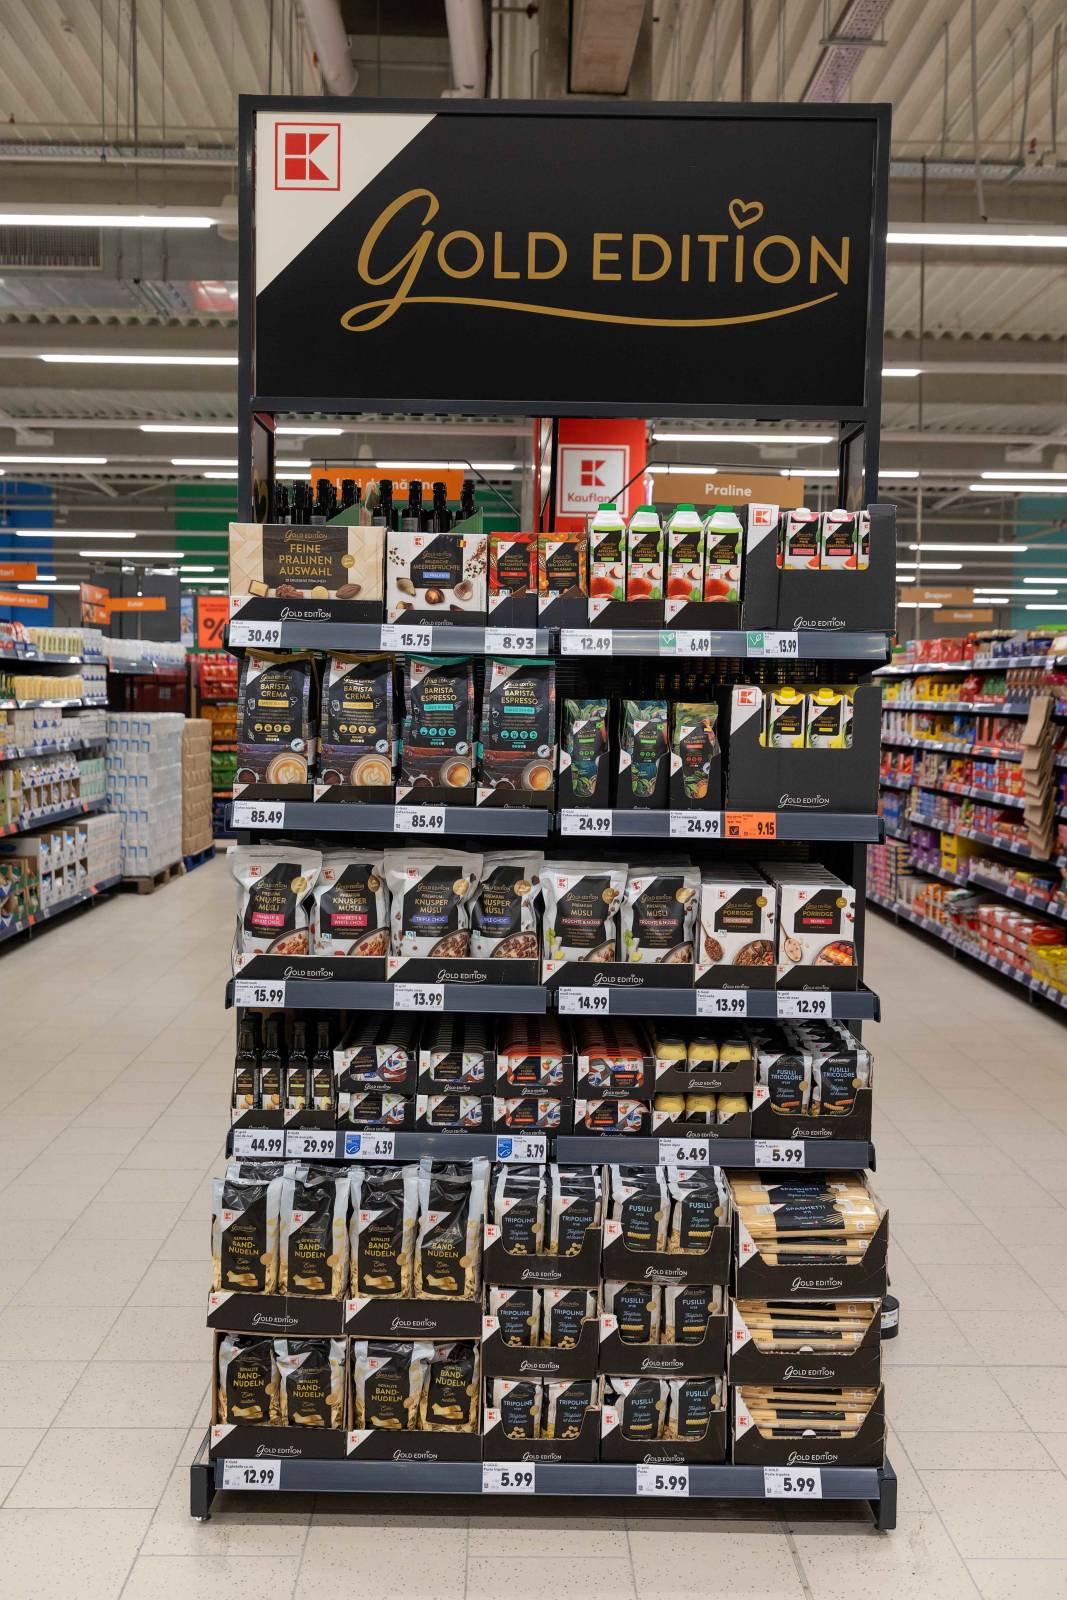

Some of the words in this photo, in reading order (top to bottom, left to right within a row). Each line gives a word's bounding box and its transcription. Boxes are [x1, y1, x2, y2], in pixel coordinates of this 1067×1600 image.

[340, 188, 567, 332] GOLD
[592, 198, 850, 284] EDITION
[705, 483, 752, 497] Praline
[290, 544, 321, 554] FEINE
[279, 554, 332, 565] PRALINEN
[279, 567, 333, 577] AUSWAHL
[279, 606, 303, 622] GOLD
[304, 608, 331, 618] EDITION
[792, 617, 817, 631] GOLD
[818, 617, 846, 627] EDITION
[248, 630, 279, 642] 30.49
[401, 633, 430, 646] 15.75
[503, 636, 534, 650] 8.93
[581, 638, 610, 651] 12.49
[690, 638, 709, 651] 6.49
[778, 640, 797, 653] 13.99
[260, 682, 290, 691] BARISTA
[343, 685, 373, 693] BARISTA
[260, 690, 288, 698] CREMA
[345, 692, 371, 700] CREMA
[420, 694, 458, 702] ESPRESSO
[504, 689, 536, 698] BARISTA
[501, 696, 539, 705] ESPRESSO
[778, 793, 802, 808] GOLD
[803, 794, 830, 804] EDITION
[251, 811, 283, 823] 85.49
[412, 815, 443, 828] 85.49
[579, 818, 610, 831] 24.99
[687, 819, 719, 832] 24.99
[758, 822, 774, 836] 9.15
[258, 903, 279, 912] MÜSLI
[338, 903, 361, 912] MÜSLI
[414, 898, 449, 906] KNUSPER
[420, 905, 442, 914] MÜSLI
[570, 908, 593, 917] MÜSLI
[646, 908, 668, 917] MÜSLI
[283, 966, 306, 980] GOLD
[306, 967, 334, 977] EDITION
[436, 968, 459, 983] GOLD
[460, 970, 487, 980] EDITION
[593, 972, 616, 986] GOLD
[617, 974, 644, 984] EDITION
[254, 989, 283, 1002] 15.99
[413, 992, 442, 1006] 13.99
[578, 996, 607, 1009] 14.99
[716, 998, 745, 1012] 13.99
[796, 1000, 826, 1013] 12.99
[688, 1079, 704, 1088] GOLD
[791, 1127, 810, 1138] GOLD
[811, 1128, 832, 1136] EDITION
[251, 1138, 282, 1152] 44.99
[303, 1140, 334, 1153] 29.99
[375, 1141, 393, 1155] 6.39
[527, 1144, 545, 1158] 5.79
[676, 1147, 707, 1160] 6.49
[772, 1148, 802, 1162] 5.99
[505, 1216, 534, 1224] TRIPOLINE
[562, 1215, 593, 1223] TRIPOLINE
[232, 1240, 255, 1249] BAND-
[298, 1243, 322, 1251] BAND-
[368, 1241, 392, 1250] BAND-
[228, 1247, 259, 1256] NUDELN
[294, 1250, 325, 1259] NUDELN
[364, 1249, 396, 1258] NUDELN
[427, 1250, 459, 1258] NUDELN
[522, 1268, 540, 1280] GOLD
[540, 1270, 562, 1278] EDITION
[644, 1266, 664, 1278] GOLD
[664, 1267, 688, 1276] EDITION
[790, 1276, 815, 1292] GOLD
[815, 1277, 843, 1286] EDITION
[620, 1296, 644, 1304] FUSILLI
[554, 1308, 584, 1316] TRIPOLINE
[252, 1312, 273, 1327] GOLD
[274, 1315, 298, 1324] EDITION
[391, 1317, 411, 1330] GOLD
[412, 1318, 437, 1327] EDITION
[519, 1360, 538, 1371] GOLD
[538, 1362, 560, 1370] EDITION
[641, 1357, 660, 1370] GOLD
[661, 1358, 684, 1367] EDITION
[237, 1372, 261, 1380] BAND-
[440, 1369, 464, 1379] BAND-
[782, 1365, 807, 1380] GOLD
[808, 1366, 835, 1376] EDITION
[233, 1378, 264, 1387] NUDELN
[296, 1384, 321, 1392] BAND-
[435, 1377, 466, 1387] NUDELN
[292, 1390, 324, 1398] NUDELN
[371, 1394, 403, 1402] NUDELN
[375, 1388, 400, 1396] BAND-
[685, 1390, 709, 1398] FUSILLI
[631, 1398, 653, 1406] FUSILLI
[256, 1444, 277, 1457] GOLD
[278, 1446, 302, 1455] EDITION
[393, 1450, 412, 1462] GOLD
[413, 1450, 438, 1460] EDITION
[521, 1451, 540, 1462] GOLD
[540, 1452, 562, 1460] EDITION
[644, 1453, 662, 1464] GOLD
[662, 1454, 684, 1462] EDITION
[787, 1450, 811, 1466] GOLD
[811, 1452, 838, 1461] EDITION
[244, 1469, 274, 1484] 12.99
[501, 1472, 533, 1486] 5.99
[655, 1475, 687, 1490] 5.99
[783, 1477, 815, 1492] 5.99
